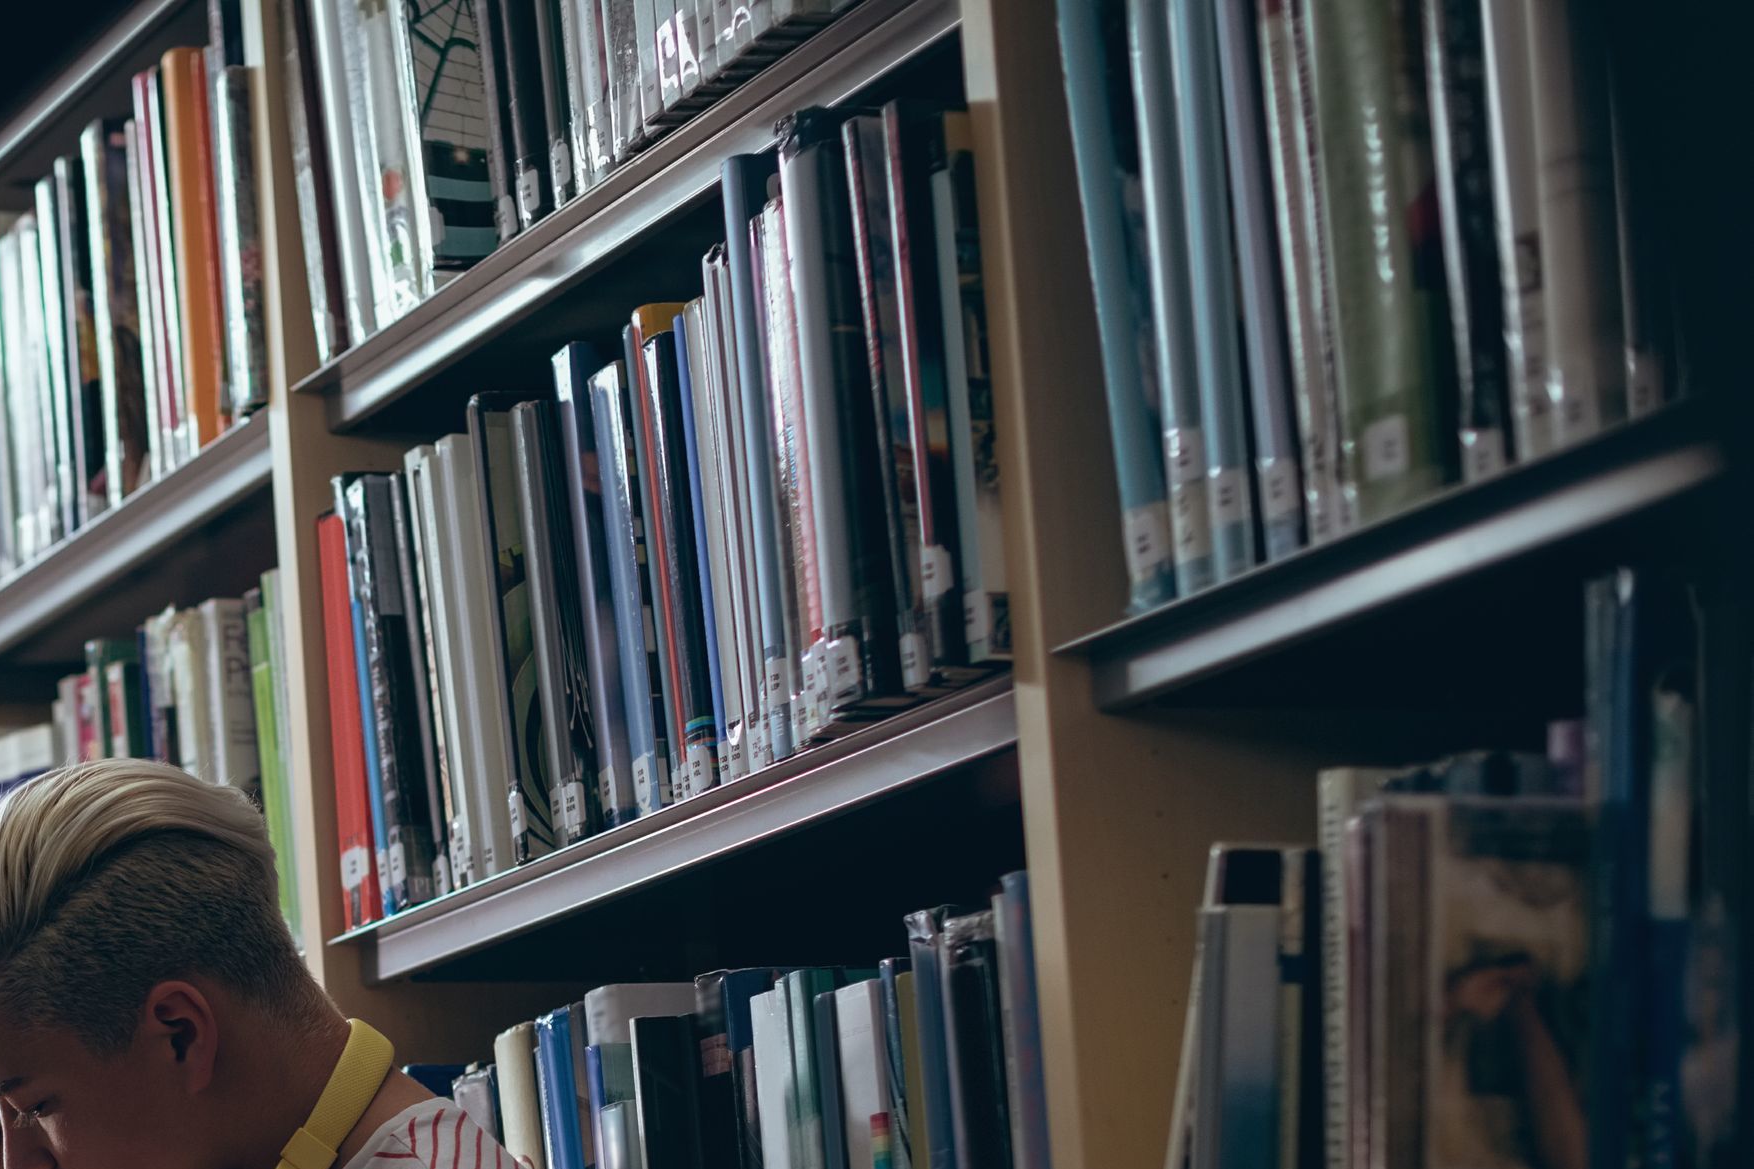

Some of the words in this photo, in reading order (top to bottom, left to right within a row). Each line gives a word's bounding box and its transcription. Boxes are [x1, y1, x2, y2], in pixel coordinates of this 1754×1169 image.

[731, 743, 740, 752] 720
[720, 755, 728, 763] 720
[692, 760, 701, 768] 720
